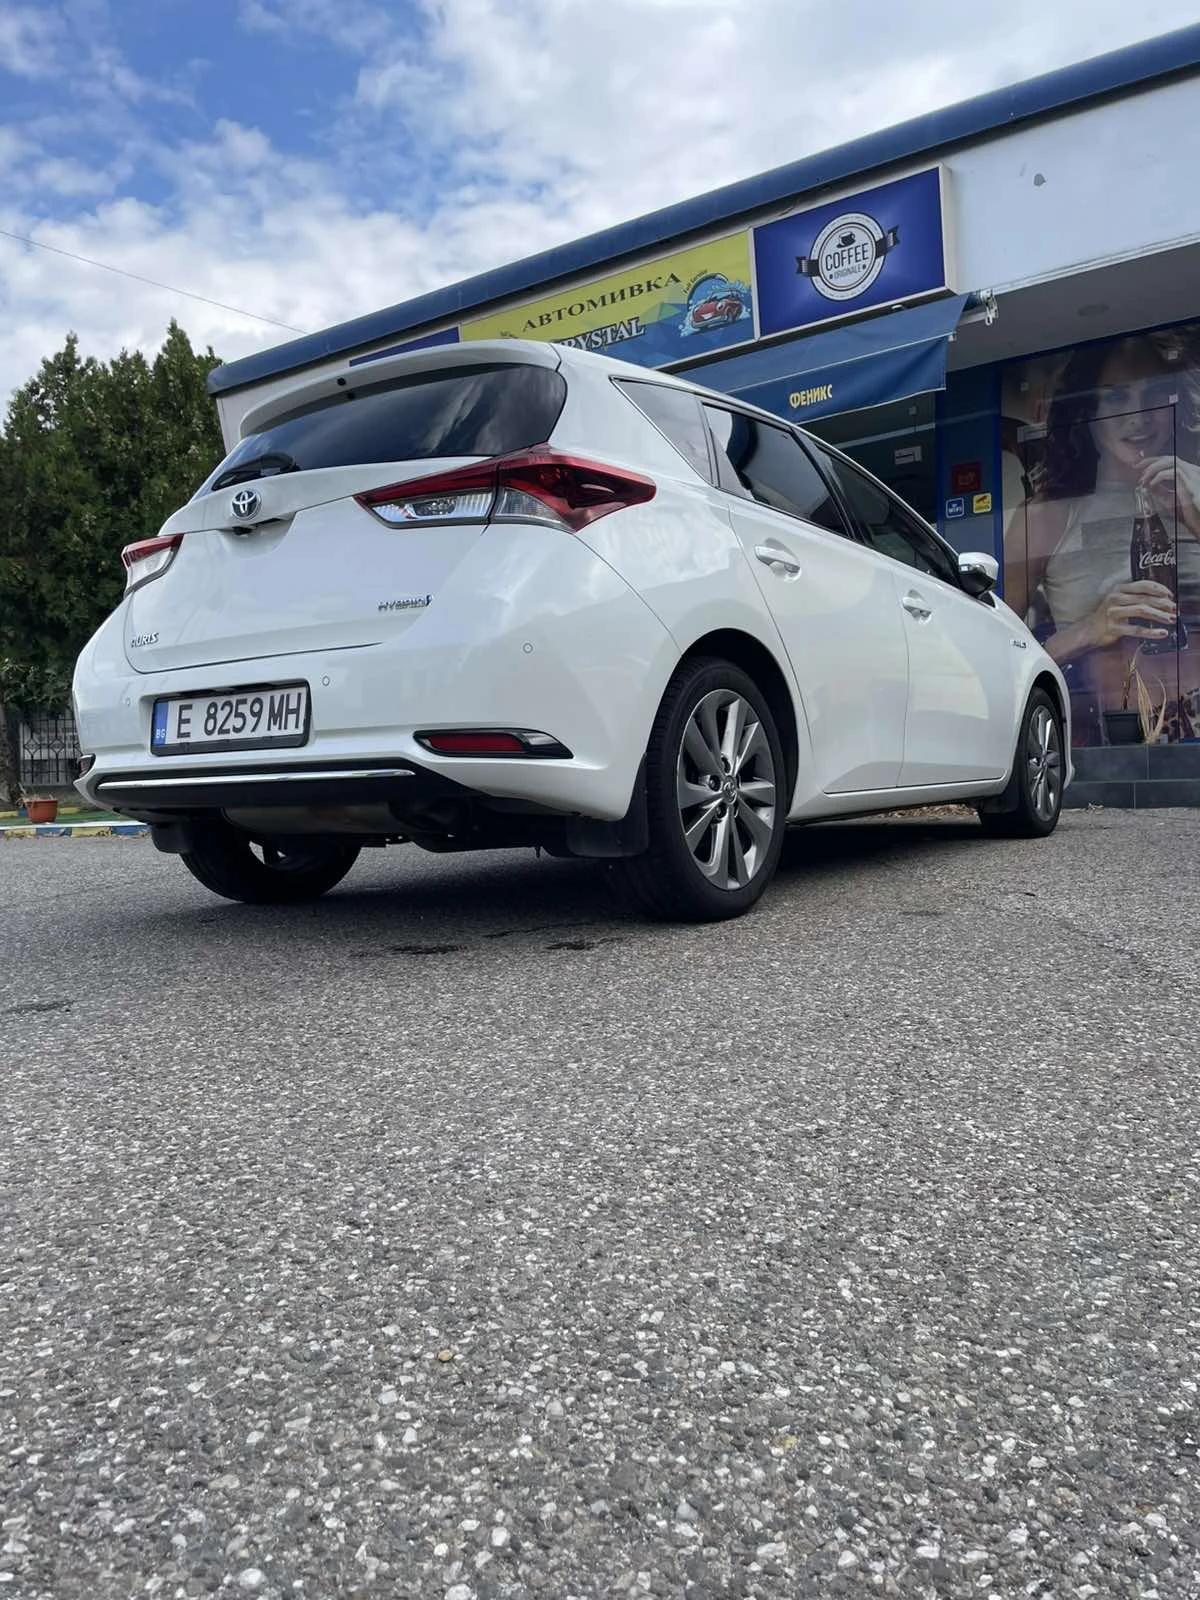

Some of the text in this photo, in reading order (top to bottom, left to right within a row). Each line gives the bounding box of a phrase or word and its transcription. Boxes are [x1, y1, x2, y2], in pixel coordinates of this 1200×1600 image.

[825, 242, 870, 271] COFFEE
[522, 272, 681, 333] АВТОМИВКА
[557, 318, 647, 351] RYSTAL
[789, 383, 833, 409] ФЕНИКС
[176, 692, 303, 738] E 8259 MH
[155, 728, 167, 739] BG
